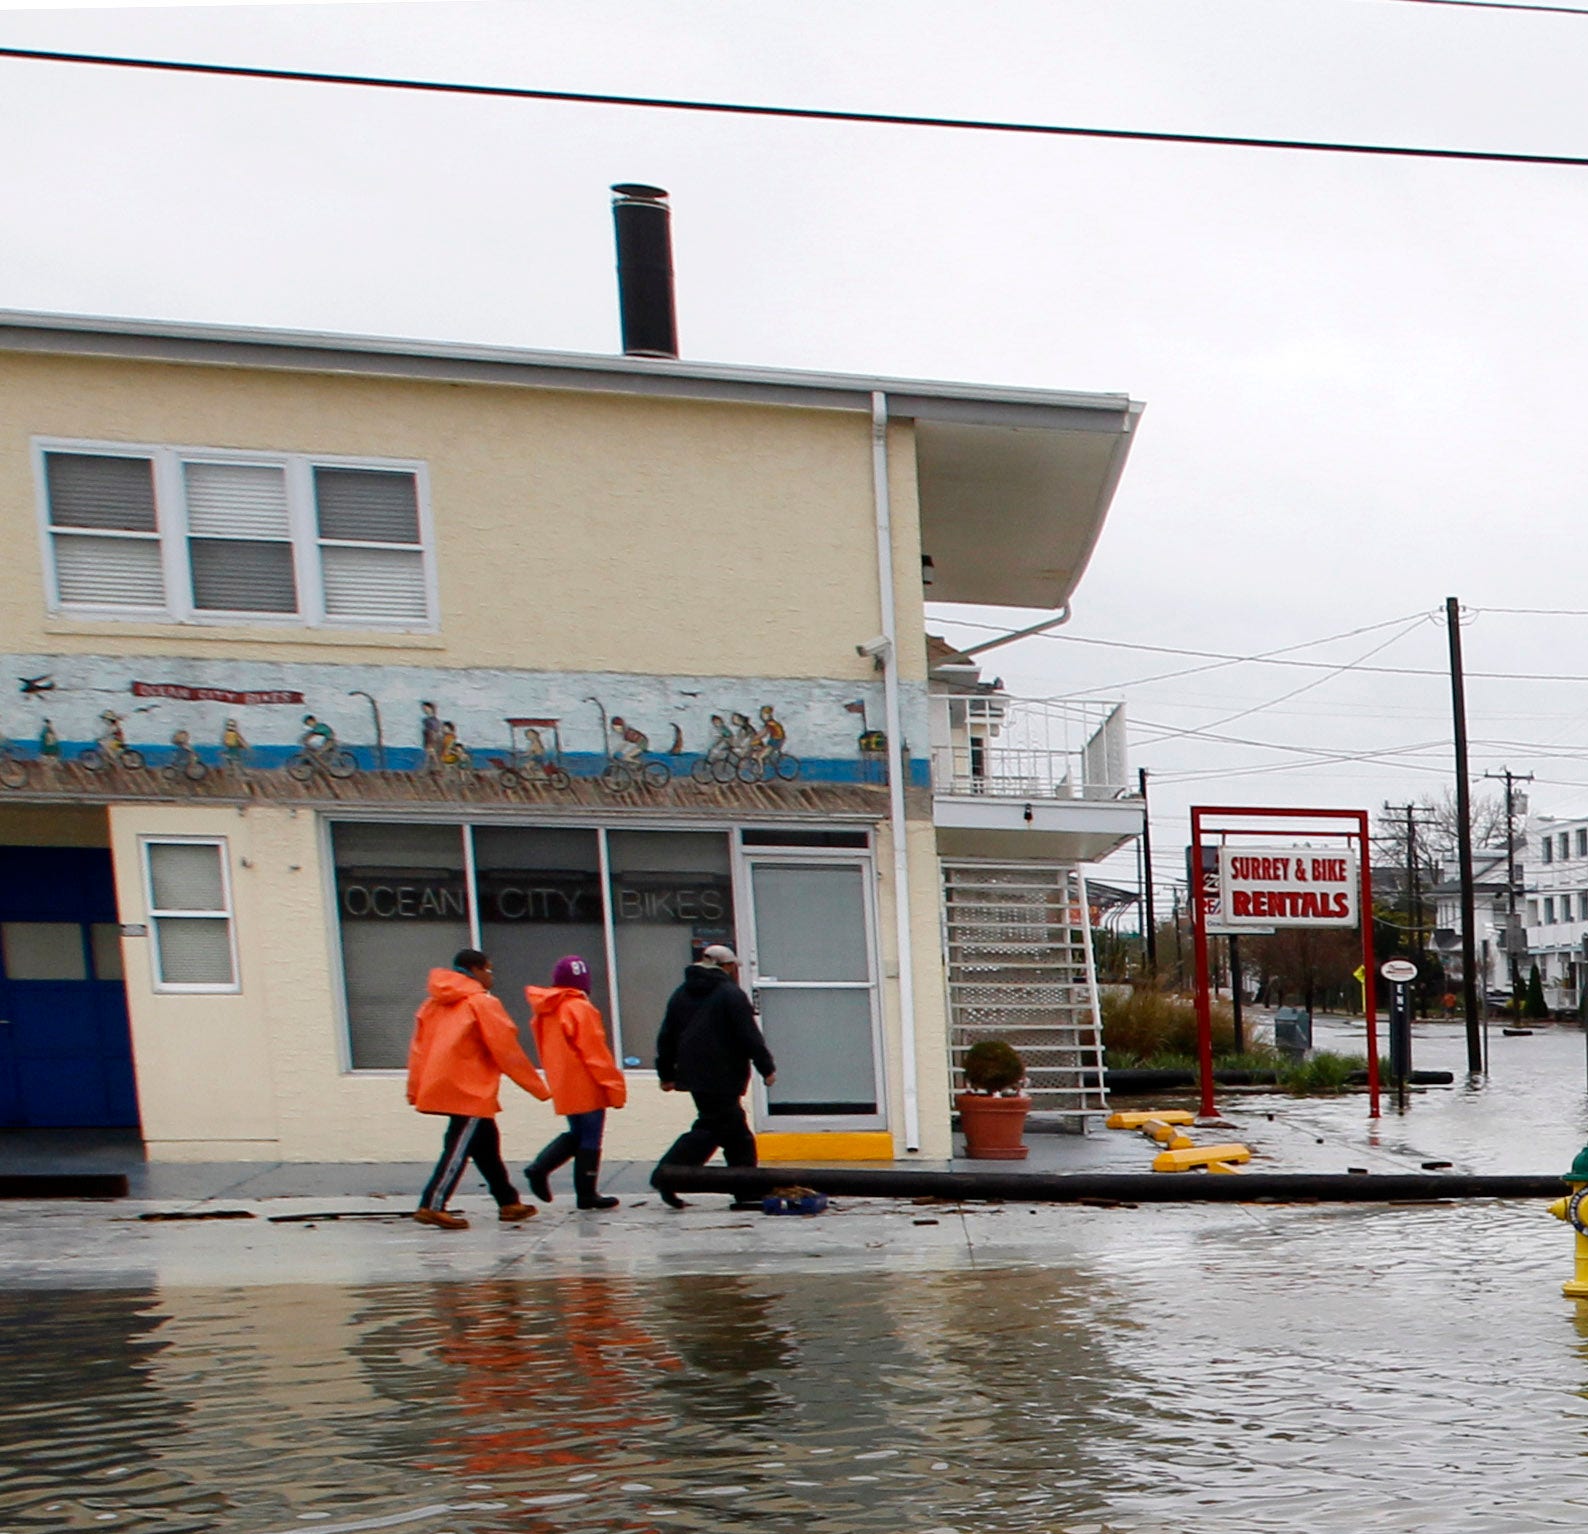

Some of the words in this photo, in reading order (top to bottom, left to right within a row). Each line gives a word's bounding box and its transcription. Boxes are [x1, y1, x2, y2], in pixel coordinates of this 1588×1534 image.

[1230, 856, 1290, 881] SURREY
[1294, 858, 1308, 882] &
[1311, 858, 1347, 882] BIKE
[344, 884, 464, 918] OCEAN
[498, 887, 581, 919] CITY
[616, 889, 725, 921] BIKES
[1232, 890, 1350, 919] RENTALS
